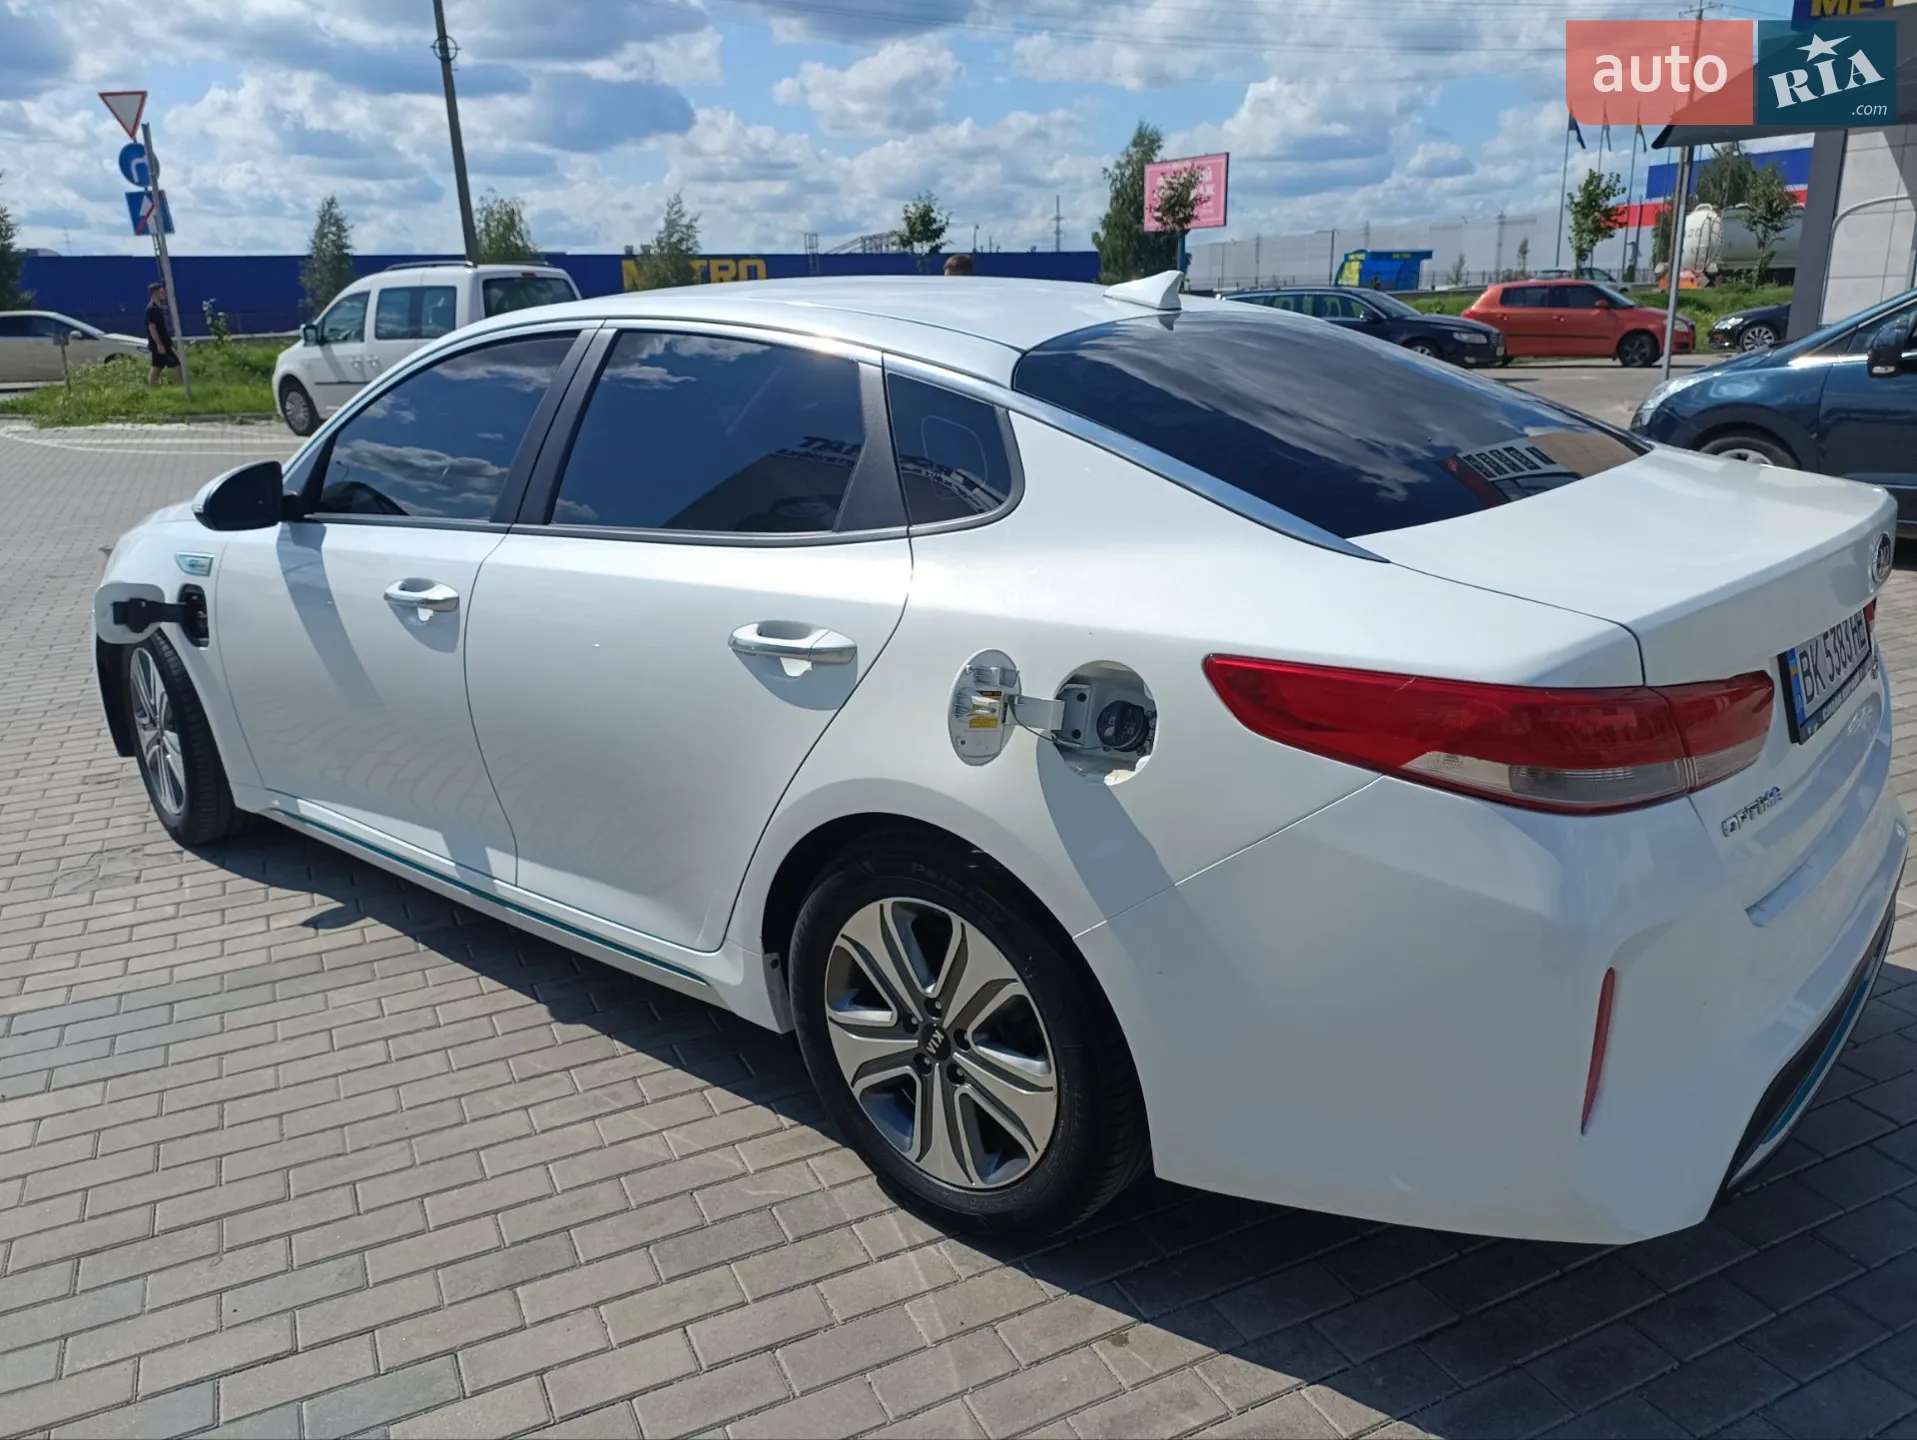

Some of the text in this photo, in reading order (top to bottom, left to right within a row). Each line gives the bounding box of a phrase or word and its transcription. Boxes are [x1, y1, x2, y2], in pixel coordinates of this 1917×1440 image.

[1799, 640, 1826, 705] BK
[1822, 619, 1853, 682] 5383
[926, 1029, 945, 1054] KIA
